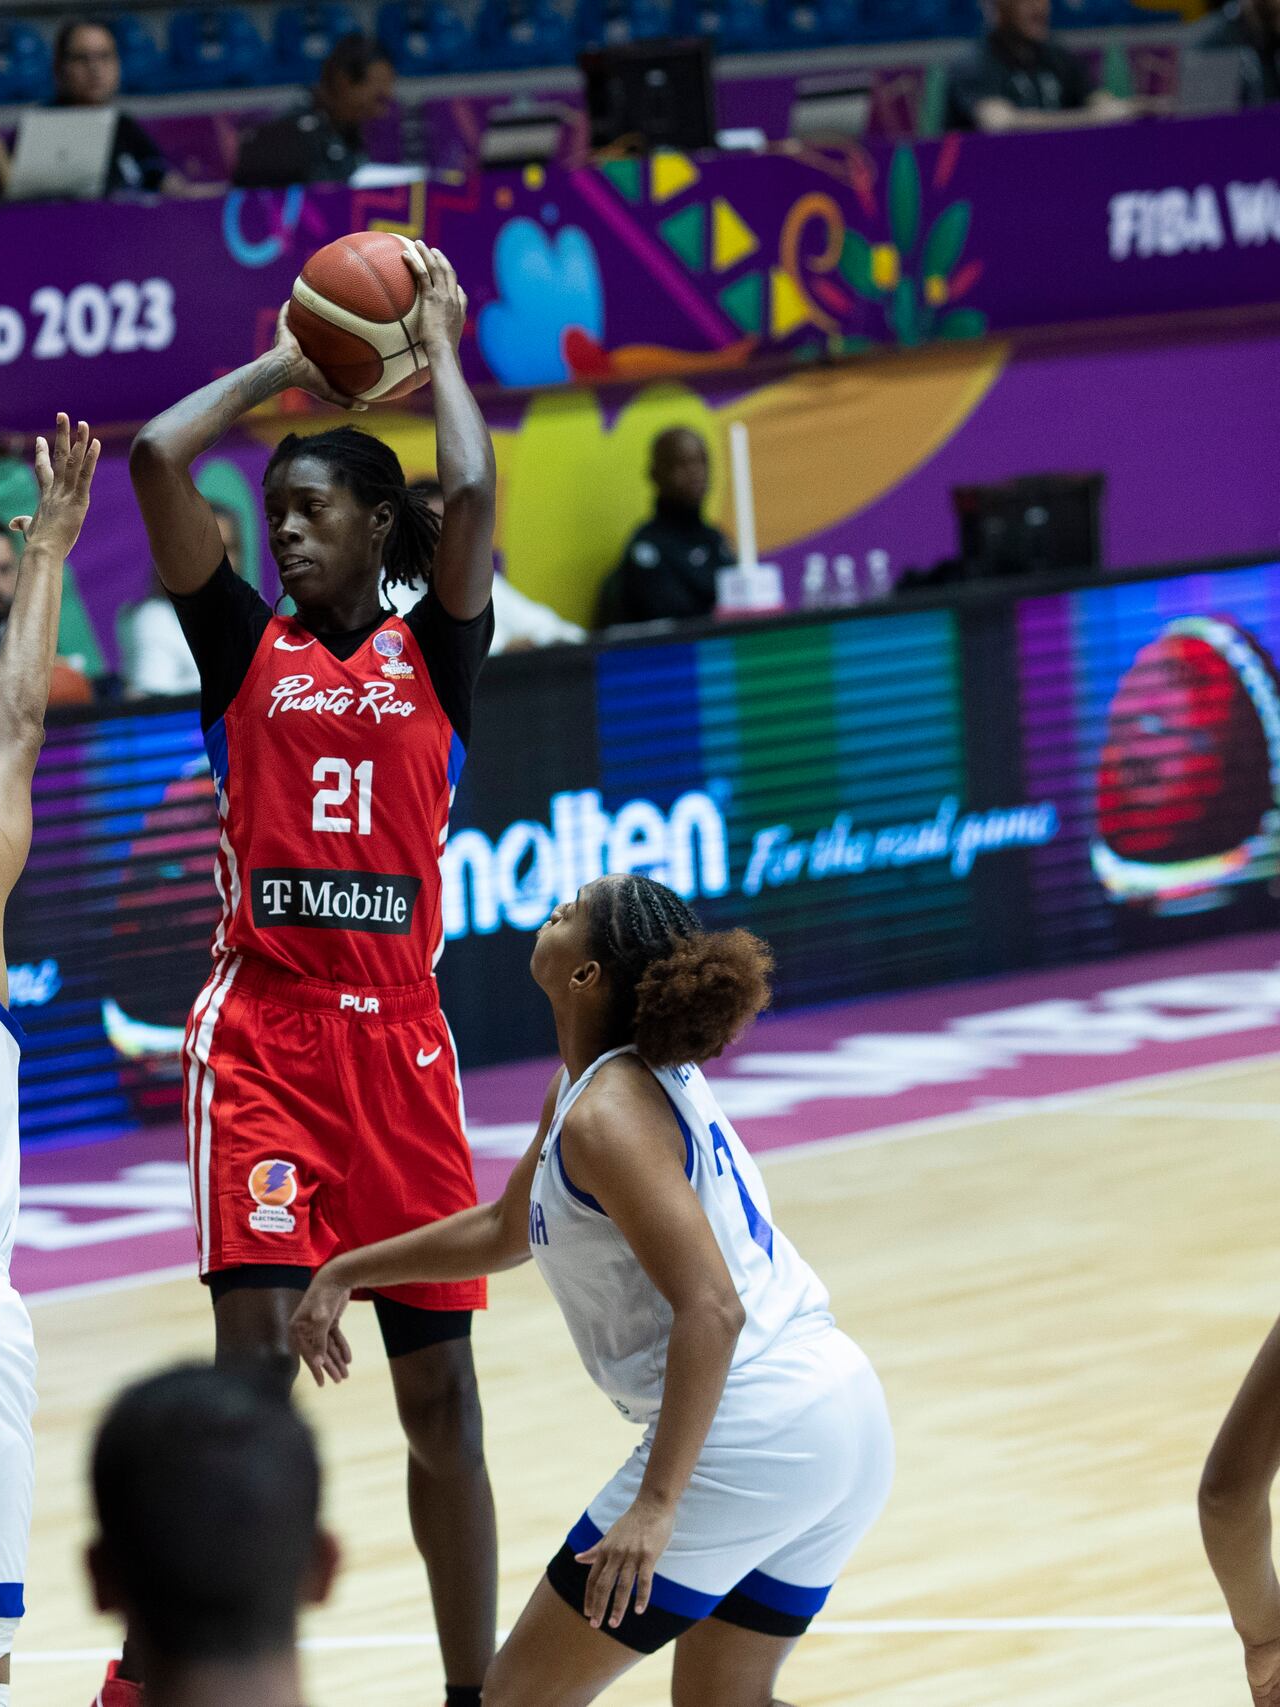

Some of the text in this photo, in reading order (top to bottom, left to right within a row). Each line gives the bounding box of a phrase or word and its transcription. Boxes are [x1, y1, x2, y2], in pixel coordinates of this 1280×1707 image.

[1107, 184, 1225, 263] FIBA
[29, 276, 176, 360] 2023
[267, 674, 417, 724] Puerto Rico
[311, 756, 374, 836] 21
[299, 881, 408, 924] Mobile
[339, 993, 380, 1014] PUR
